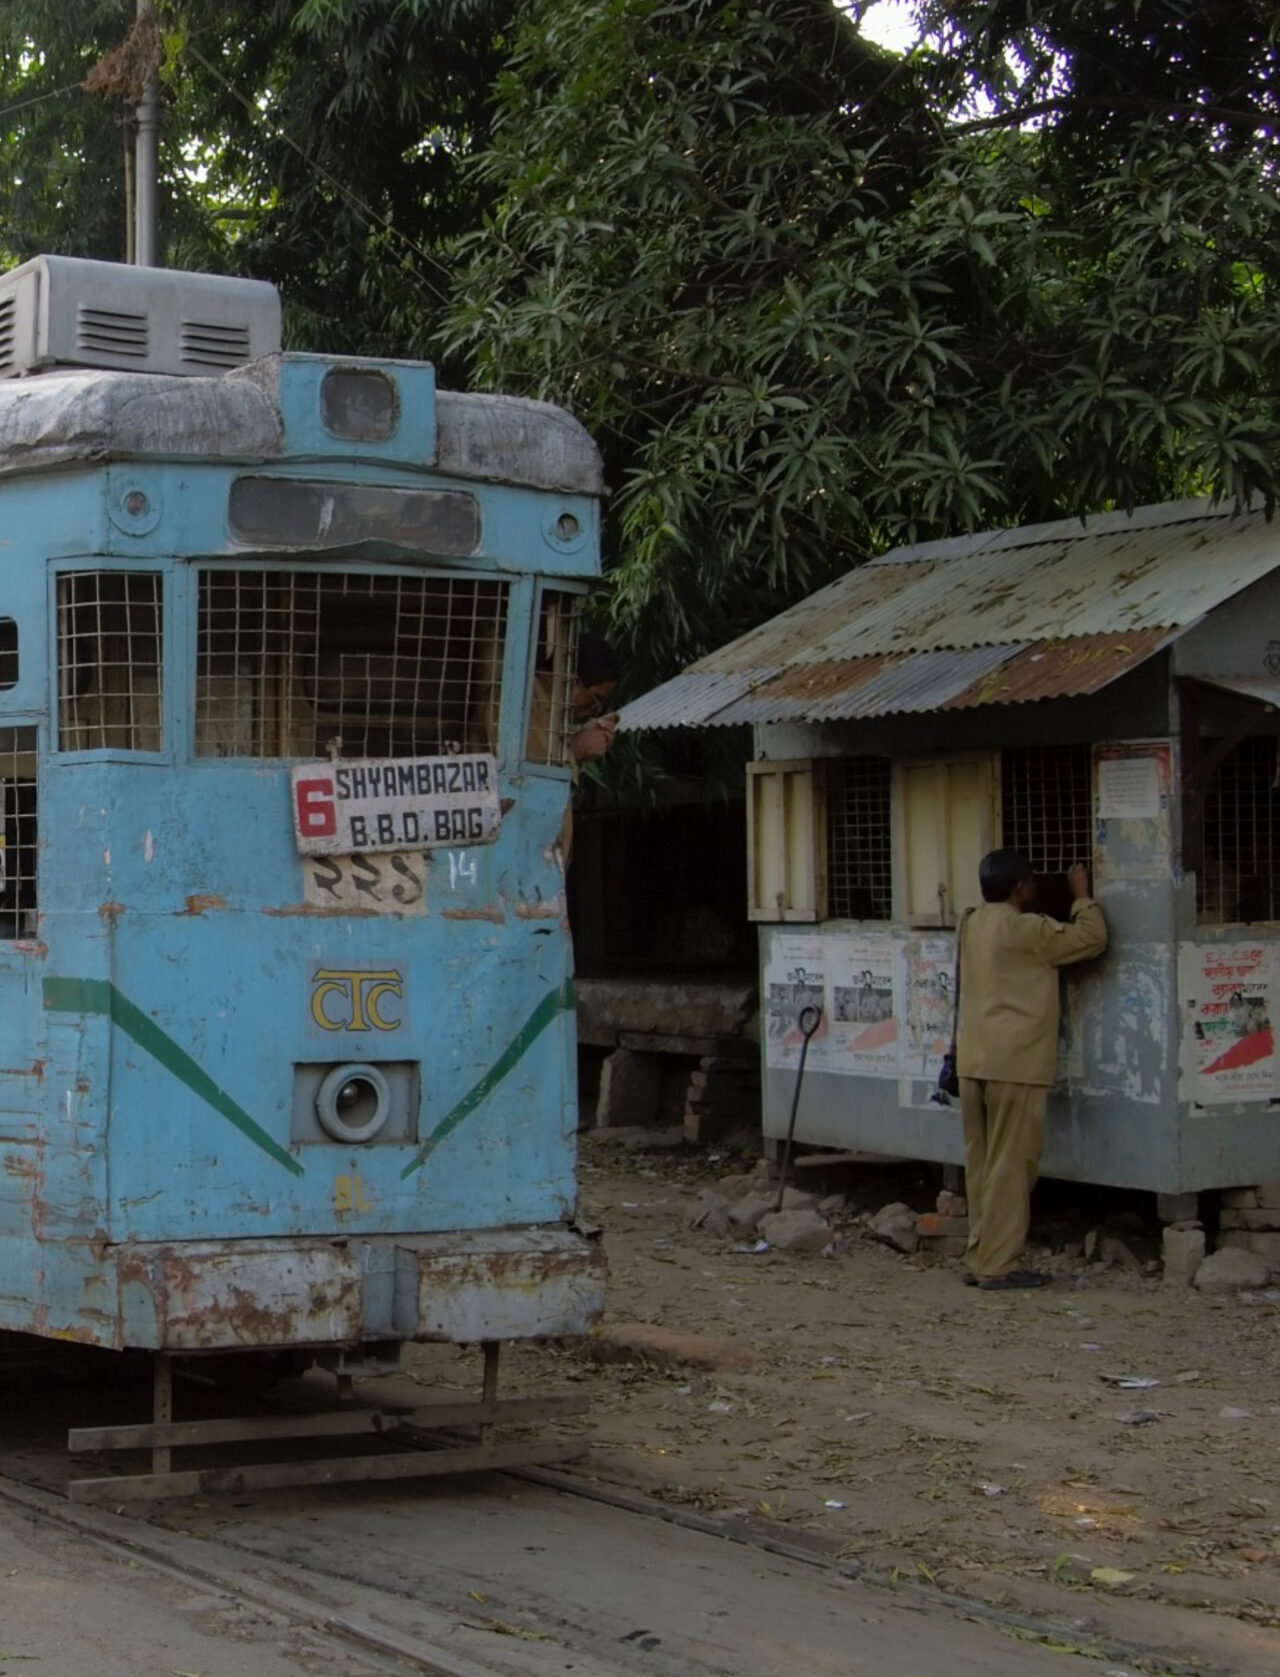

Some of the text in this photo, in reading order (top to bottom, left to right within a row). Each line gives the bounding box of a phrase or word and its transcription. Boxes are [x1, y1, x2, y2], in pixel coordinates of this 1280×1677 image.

[296, 761, 489, 838] 6 SHYAMBAZAR
[434, 807, 483, 841] BAG
[448, 851, 477, 890] 14
[311, 969, 403, 1031] CTC
